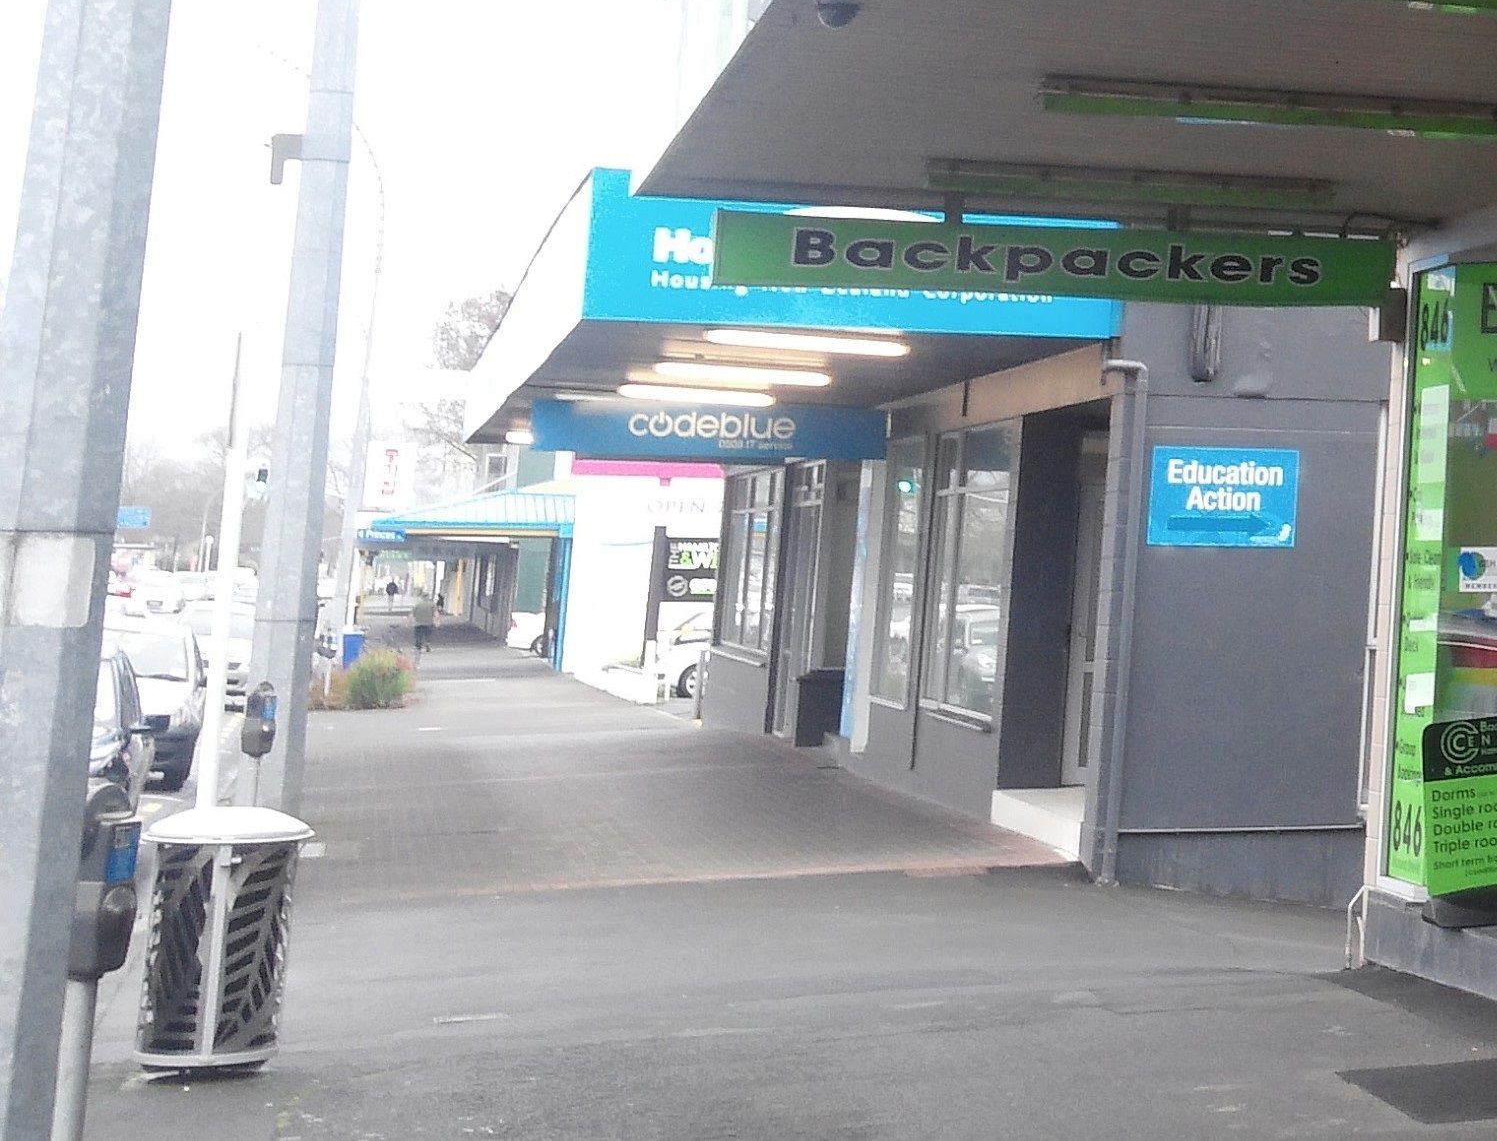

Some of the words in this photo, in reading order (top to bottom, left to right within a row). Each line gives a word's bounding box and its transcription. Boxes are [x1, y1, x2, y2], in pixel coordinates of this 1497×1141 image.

[791, 226, 1323, 286] Backpackers
[628, 411, 796, 439] codeblue
[1167, 458, 1284, 486] Education
[1185, 486, 1261, 511] Action
[1444, 767, 1456, 776] &
[1432, 788, 1476, 803] Dorms
[1432, 804, 1474, 822] Single
[1393, 800, 1422, 857] 846
[1433, 819, 1484, 837] Double
[1433, 836, 1474, 856] Triple
[1433, 858, 1459, 870] Short
[1461, 856, 1485, 867] term
